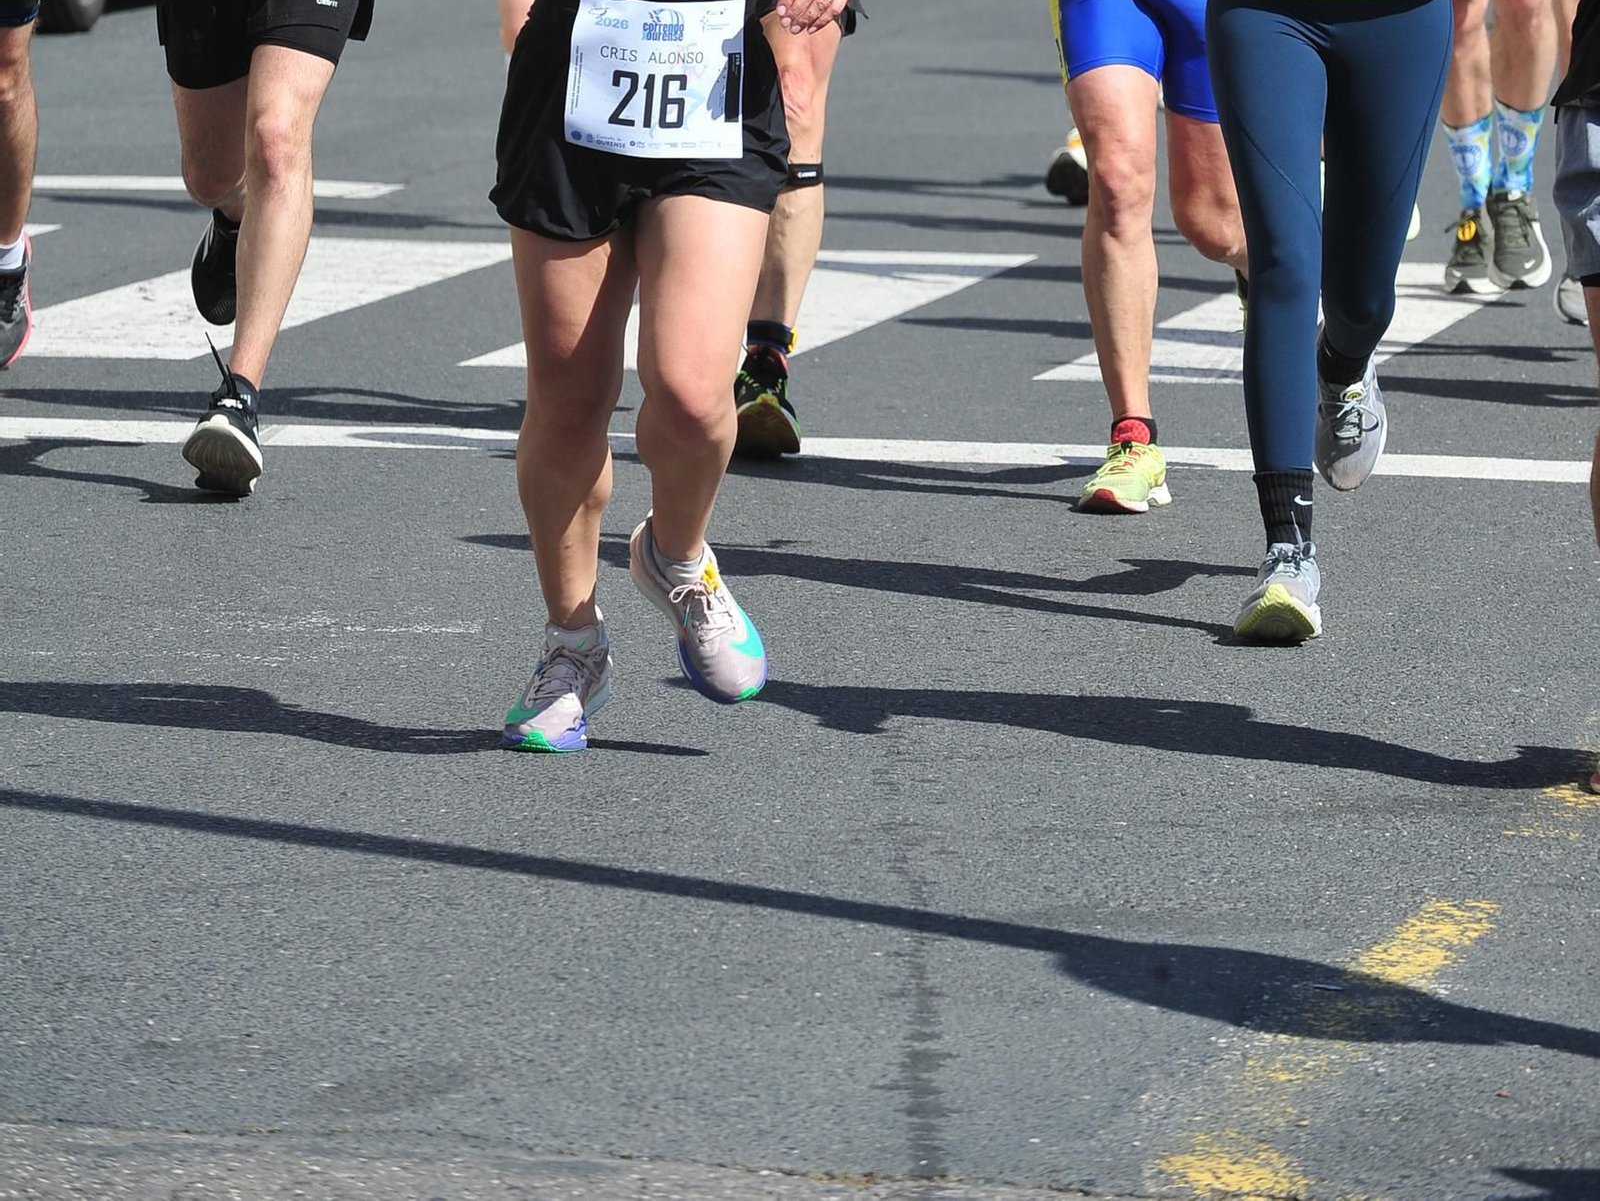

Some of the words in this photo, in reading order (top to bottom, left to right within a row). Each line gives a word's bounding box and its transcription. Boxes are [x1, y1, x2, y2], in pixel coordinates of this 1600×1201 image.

[595, 16, 629, 30] 2026
[600, 45, 638, 62] CRIS
[648, 51, 704, 64] ALONSO
[608, 69, 688, 129] 216
